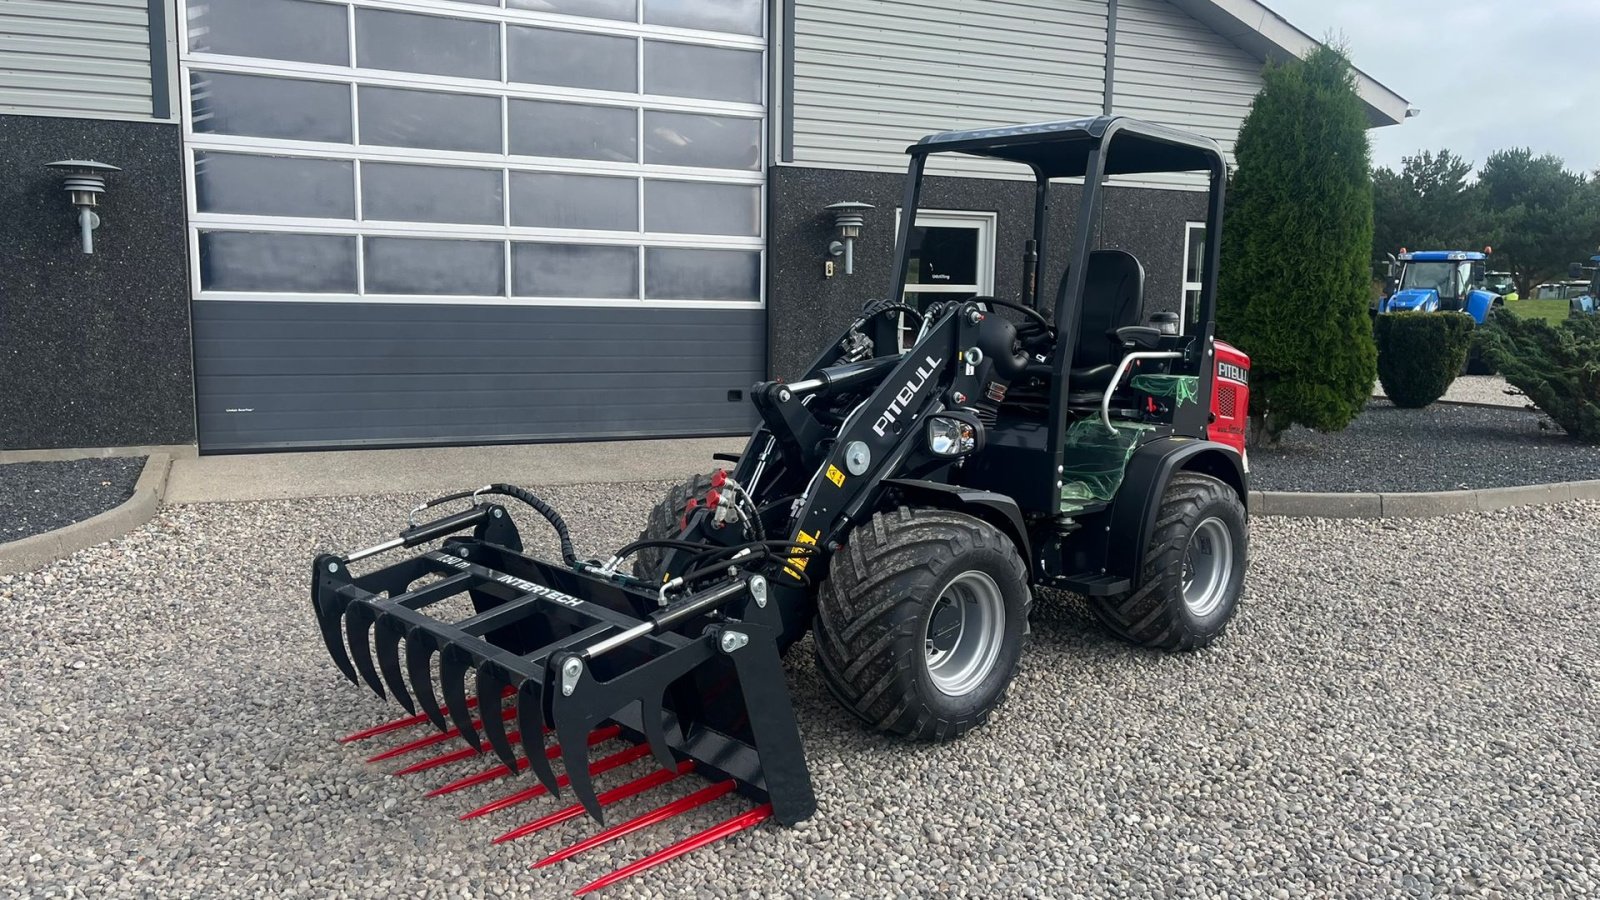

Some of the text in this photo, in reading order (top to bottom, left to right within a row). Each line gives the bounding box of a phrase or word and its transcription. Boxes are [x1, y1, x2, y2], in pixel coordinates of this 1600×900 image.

[1218, 362, 1248, 384] PITBULL
[872, 355, 942, 437] PITBULL
[498, 574, 585, 607] INTERTECH
